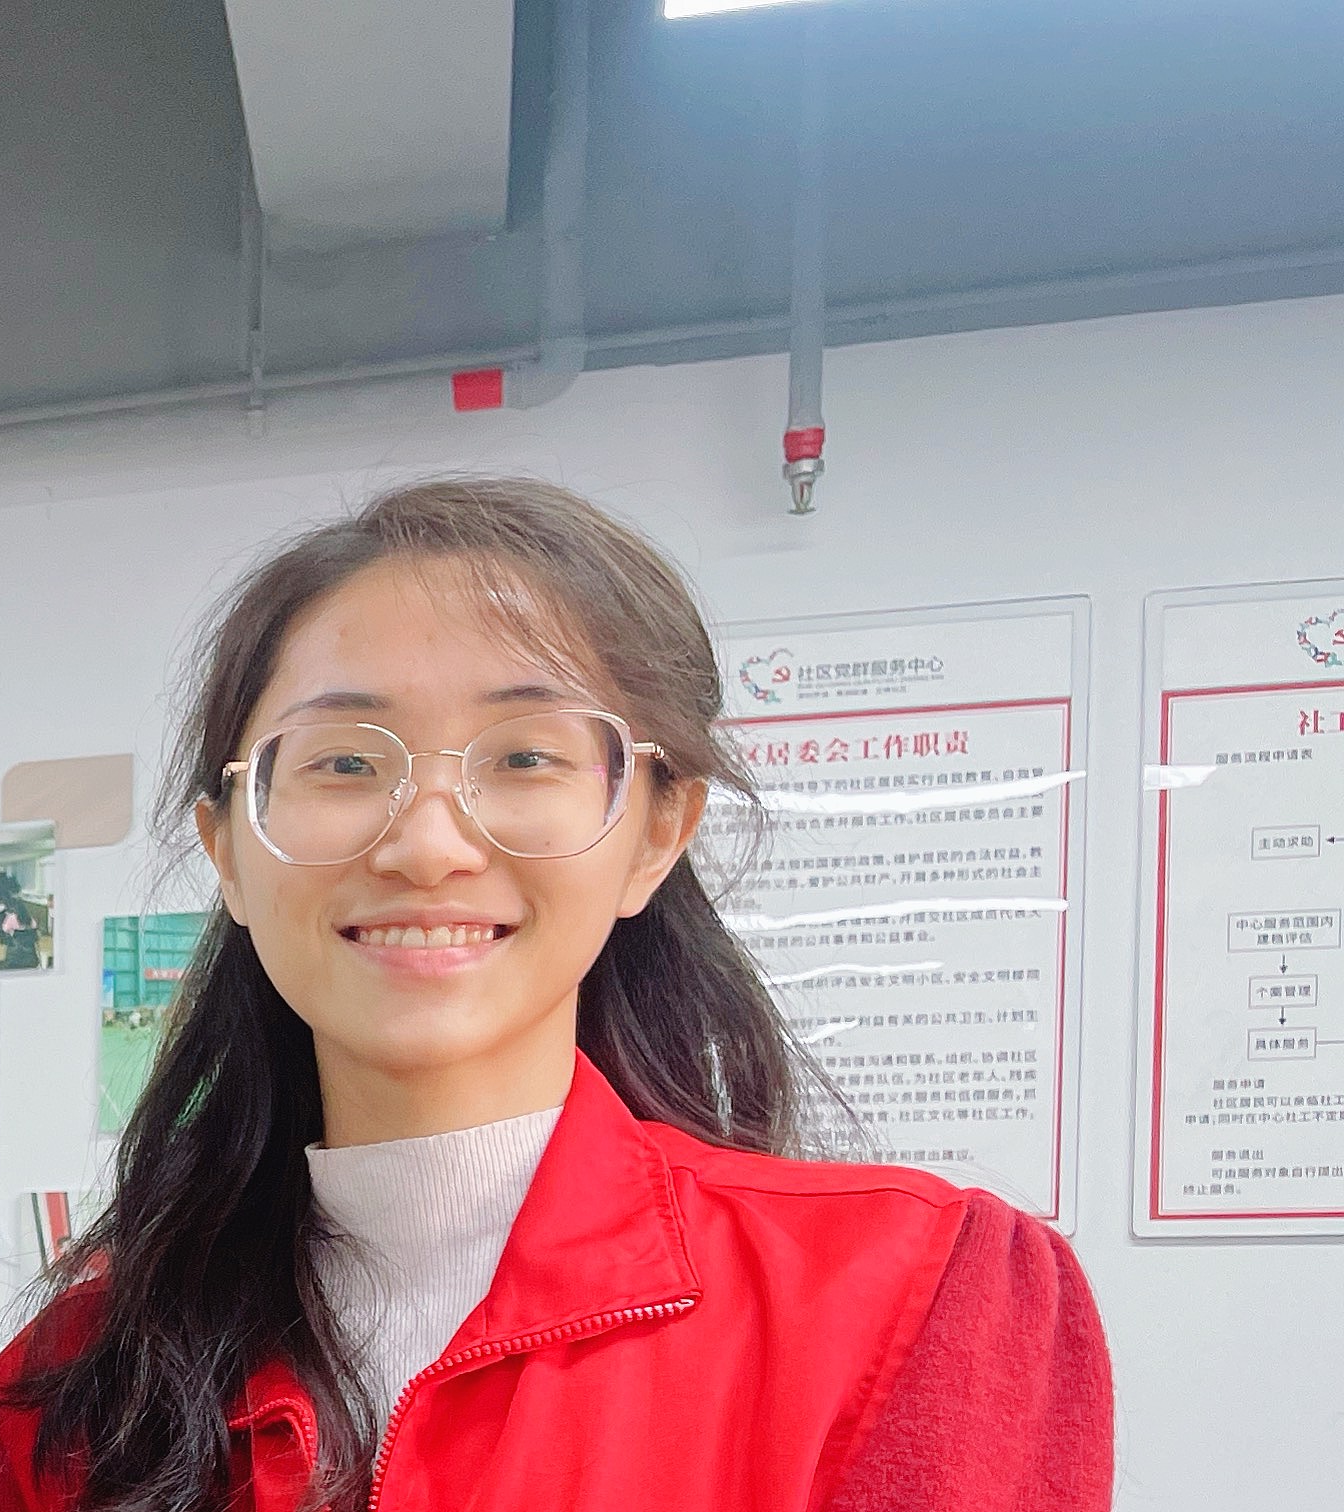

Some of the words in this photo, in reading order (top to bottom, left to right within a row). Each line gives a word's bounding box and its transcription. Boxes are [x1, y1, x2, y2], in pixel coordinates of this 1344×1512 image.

[798, 655, 944, 682] 社区党群服务中心
